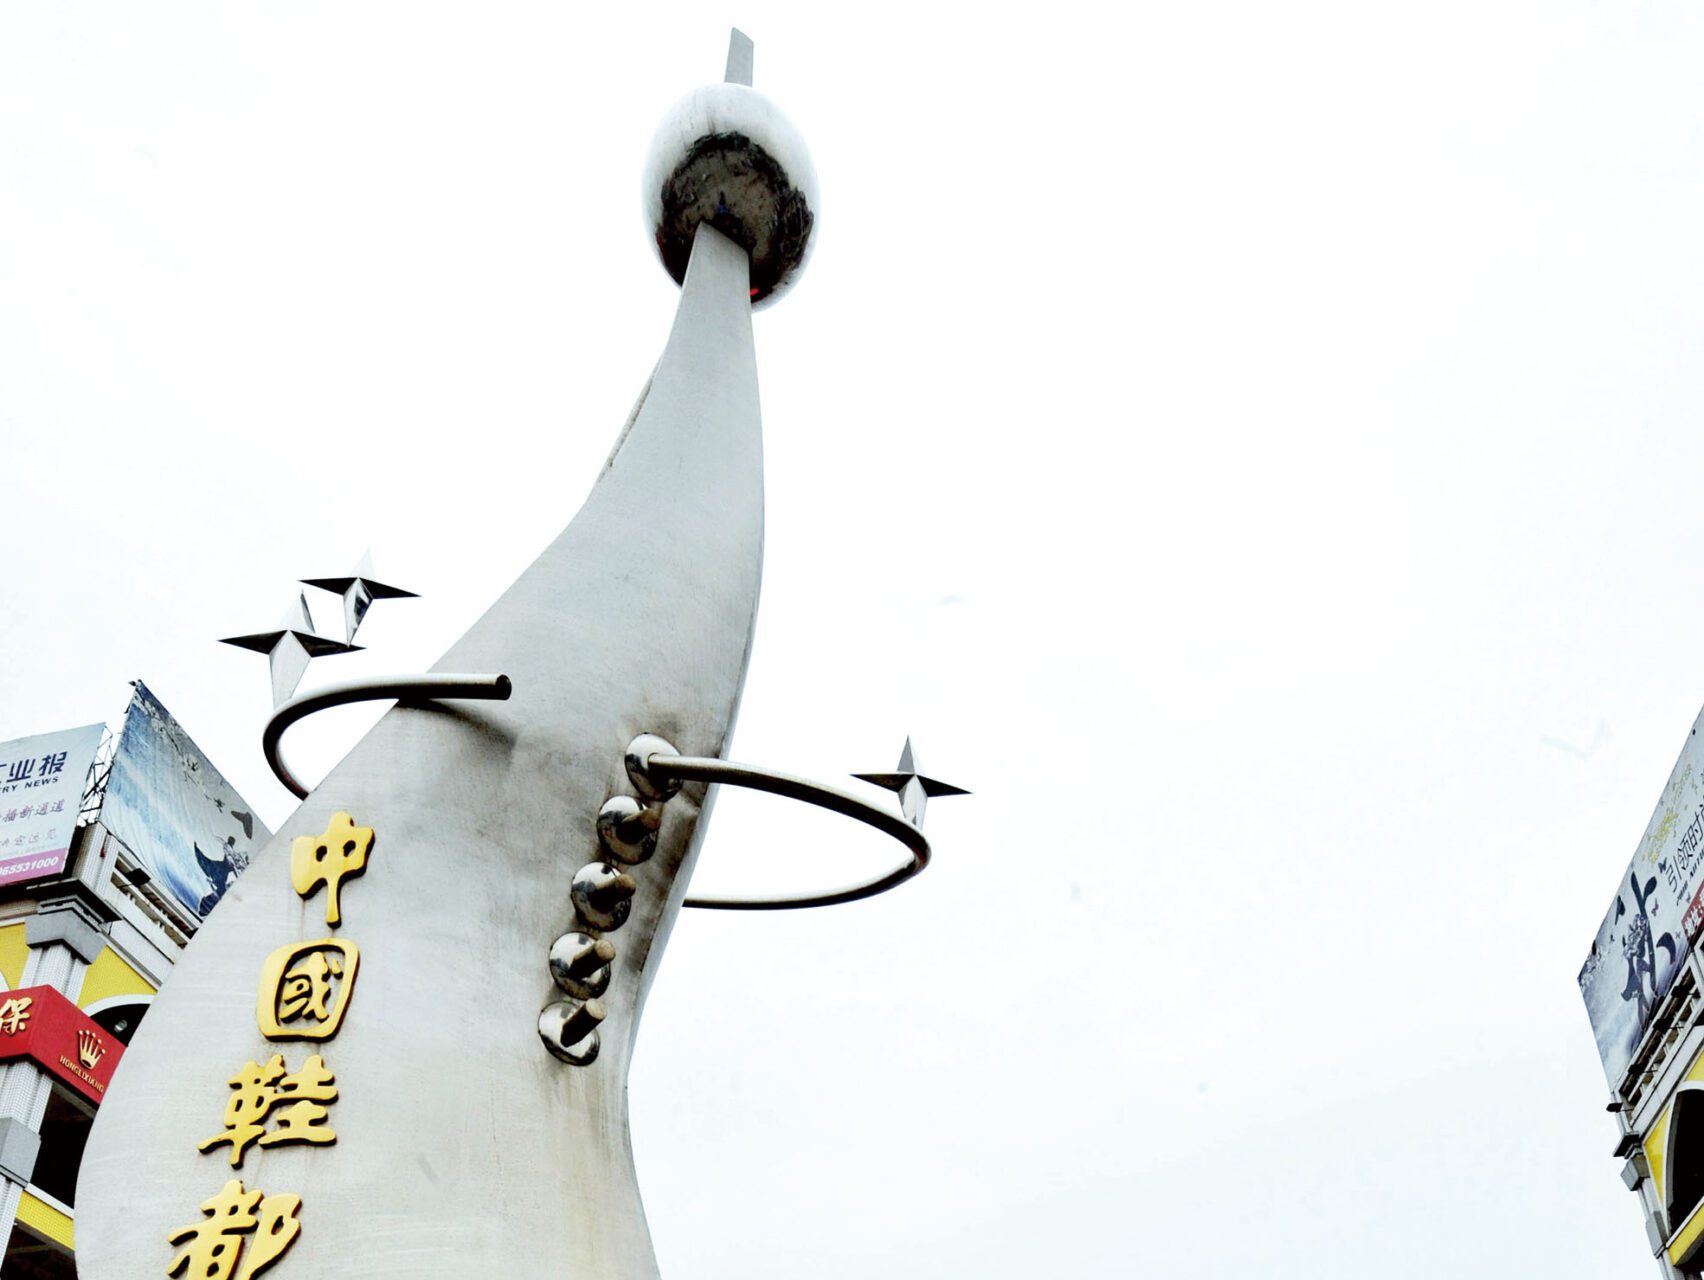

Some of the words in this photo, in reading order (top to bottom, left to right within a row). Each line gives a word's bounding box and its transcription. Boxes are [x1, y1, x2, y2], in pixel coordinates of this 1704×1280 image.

[25, 776, 59, 788] NEWS
[0, 856, 59, 876] 65531000
[60, 1055, 104, 1093] HONGLIXIANG
